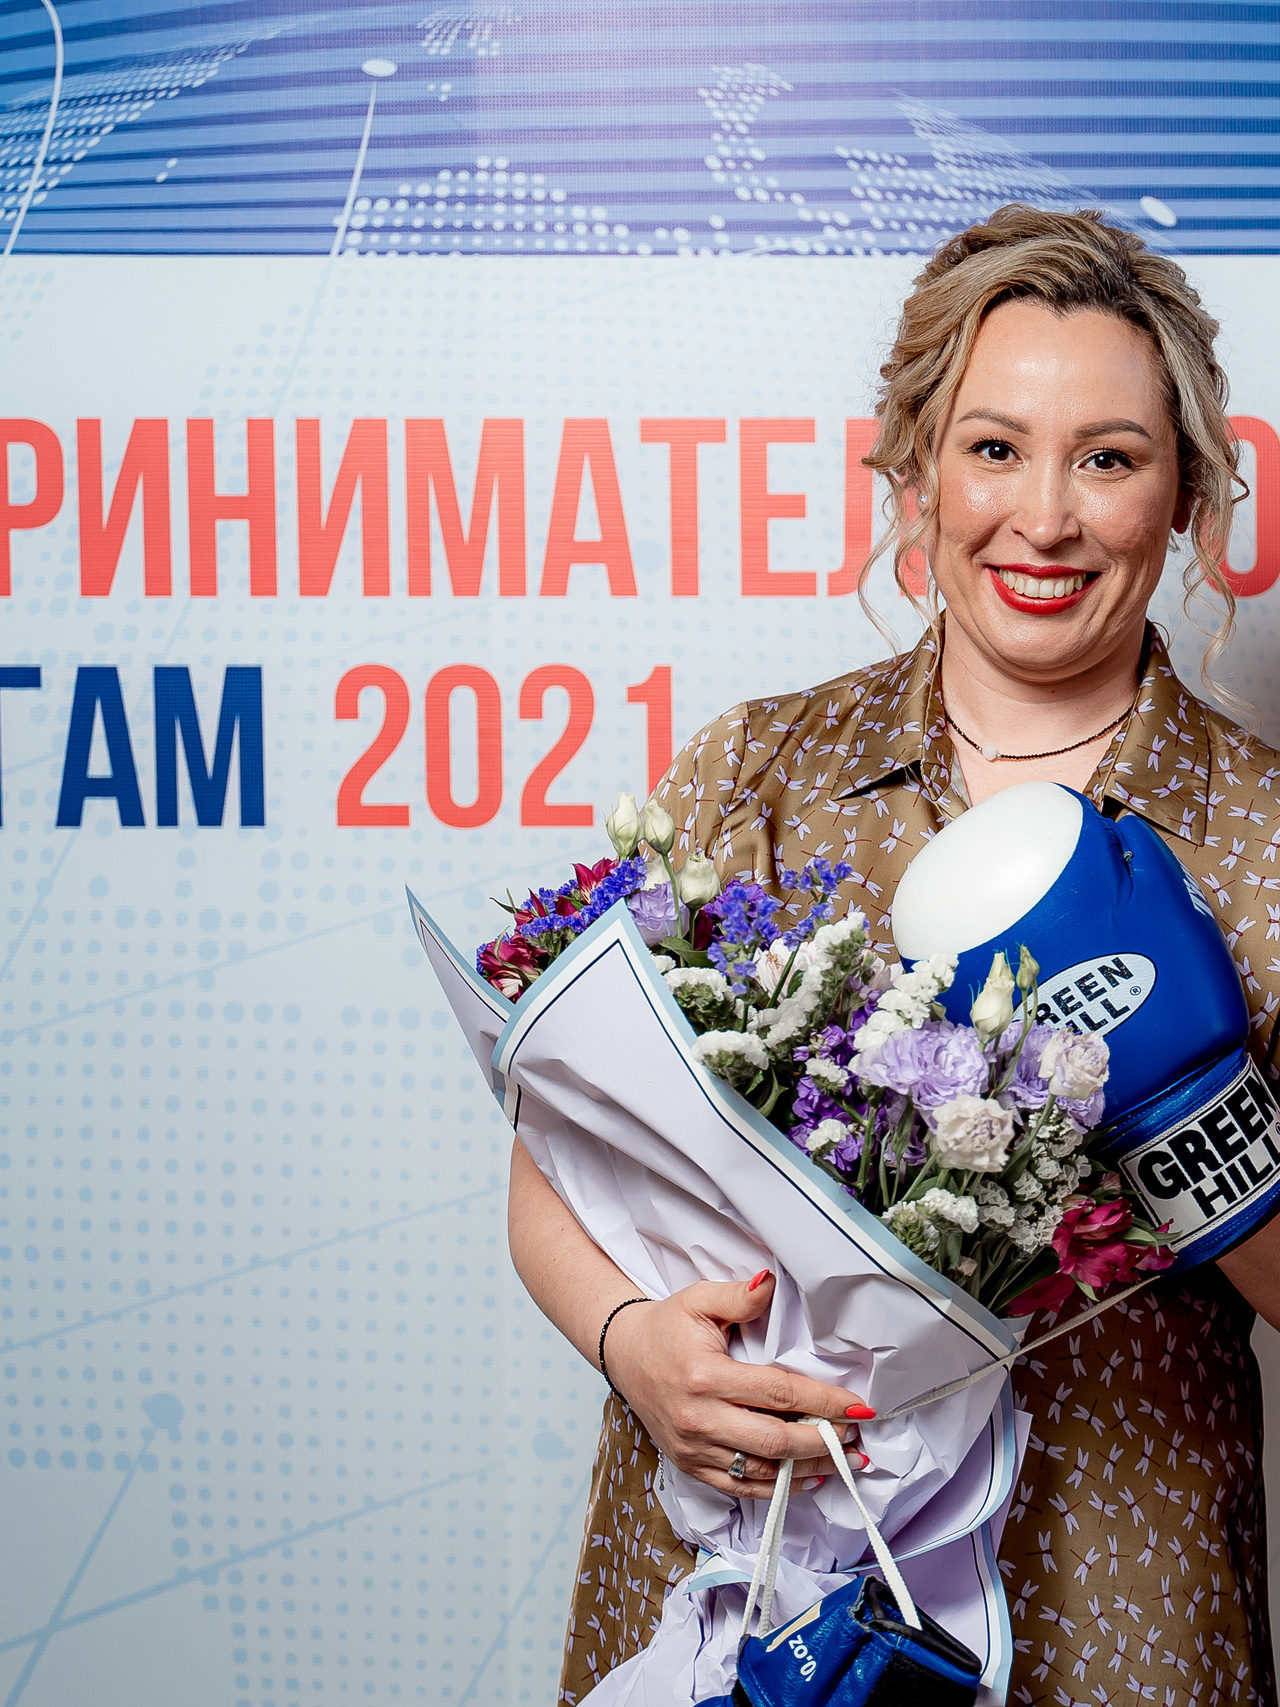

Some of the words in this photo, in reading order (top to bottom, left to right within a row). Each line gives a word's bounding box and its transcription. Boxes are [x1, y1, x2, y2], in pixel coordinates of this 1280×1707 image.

[0, 665, 266, 829] АМ
[333, 663, 675, 829] 2021
[1137, 1075, 1274, 1200] GREEN
